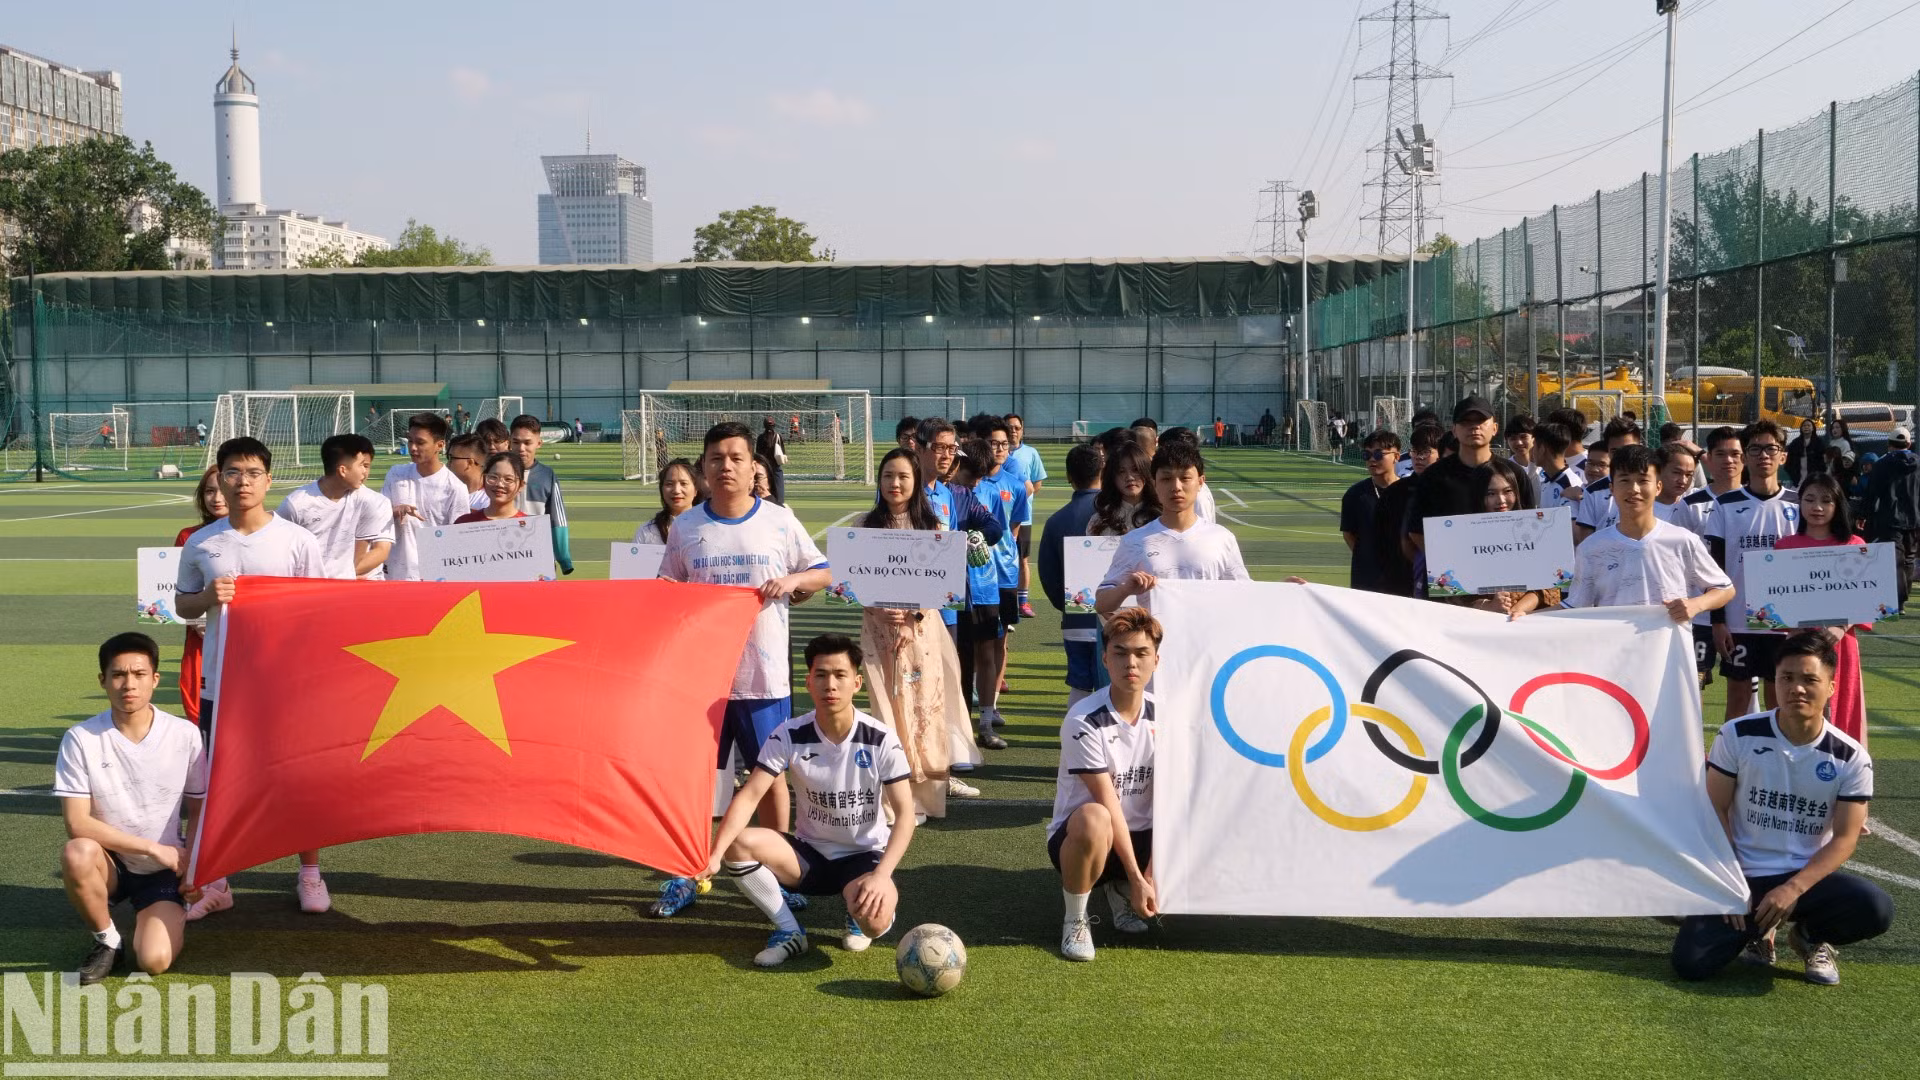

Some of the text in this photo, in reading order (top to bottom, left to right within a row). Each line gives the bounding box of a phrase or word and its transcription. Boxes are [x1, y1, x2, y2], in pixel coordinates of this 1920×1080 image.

[490, 552, 504, 562] AN
[507, 549, 533, 560] NINH
[732, 555, 745, 566] SINH
[736, 573, 750, 584] KINH
[849, 564, 872, 575] CÁN
[891, 567, 922, 577] CNVC
[924, 569, 947, 579] ĐSQ
[1793, 583, 1816, 593] LHS
[1861, 580, 1877, 589] TN
[1733, 644, 1747, 667] 2
[1748, 786, 1828, 818] 北京越南留学生会
[862, 809, 875, 823] Kinh
[1757, 812, 1771, 830] Việt
[1771, 815, 1788, 831] Nam
[1808, 822, 1824, 835] Kinh
